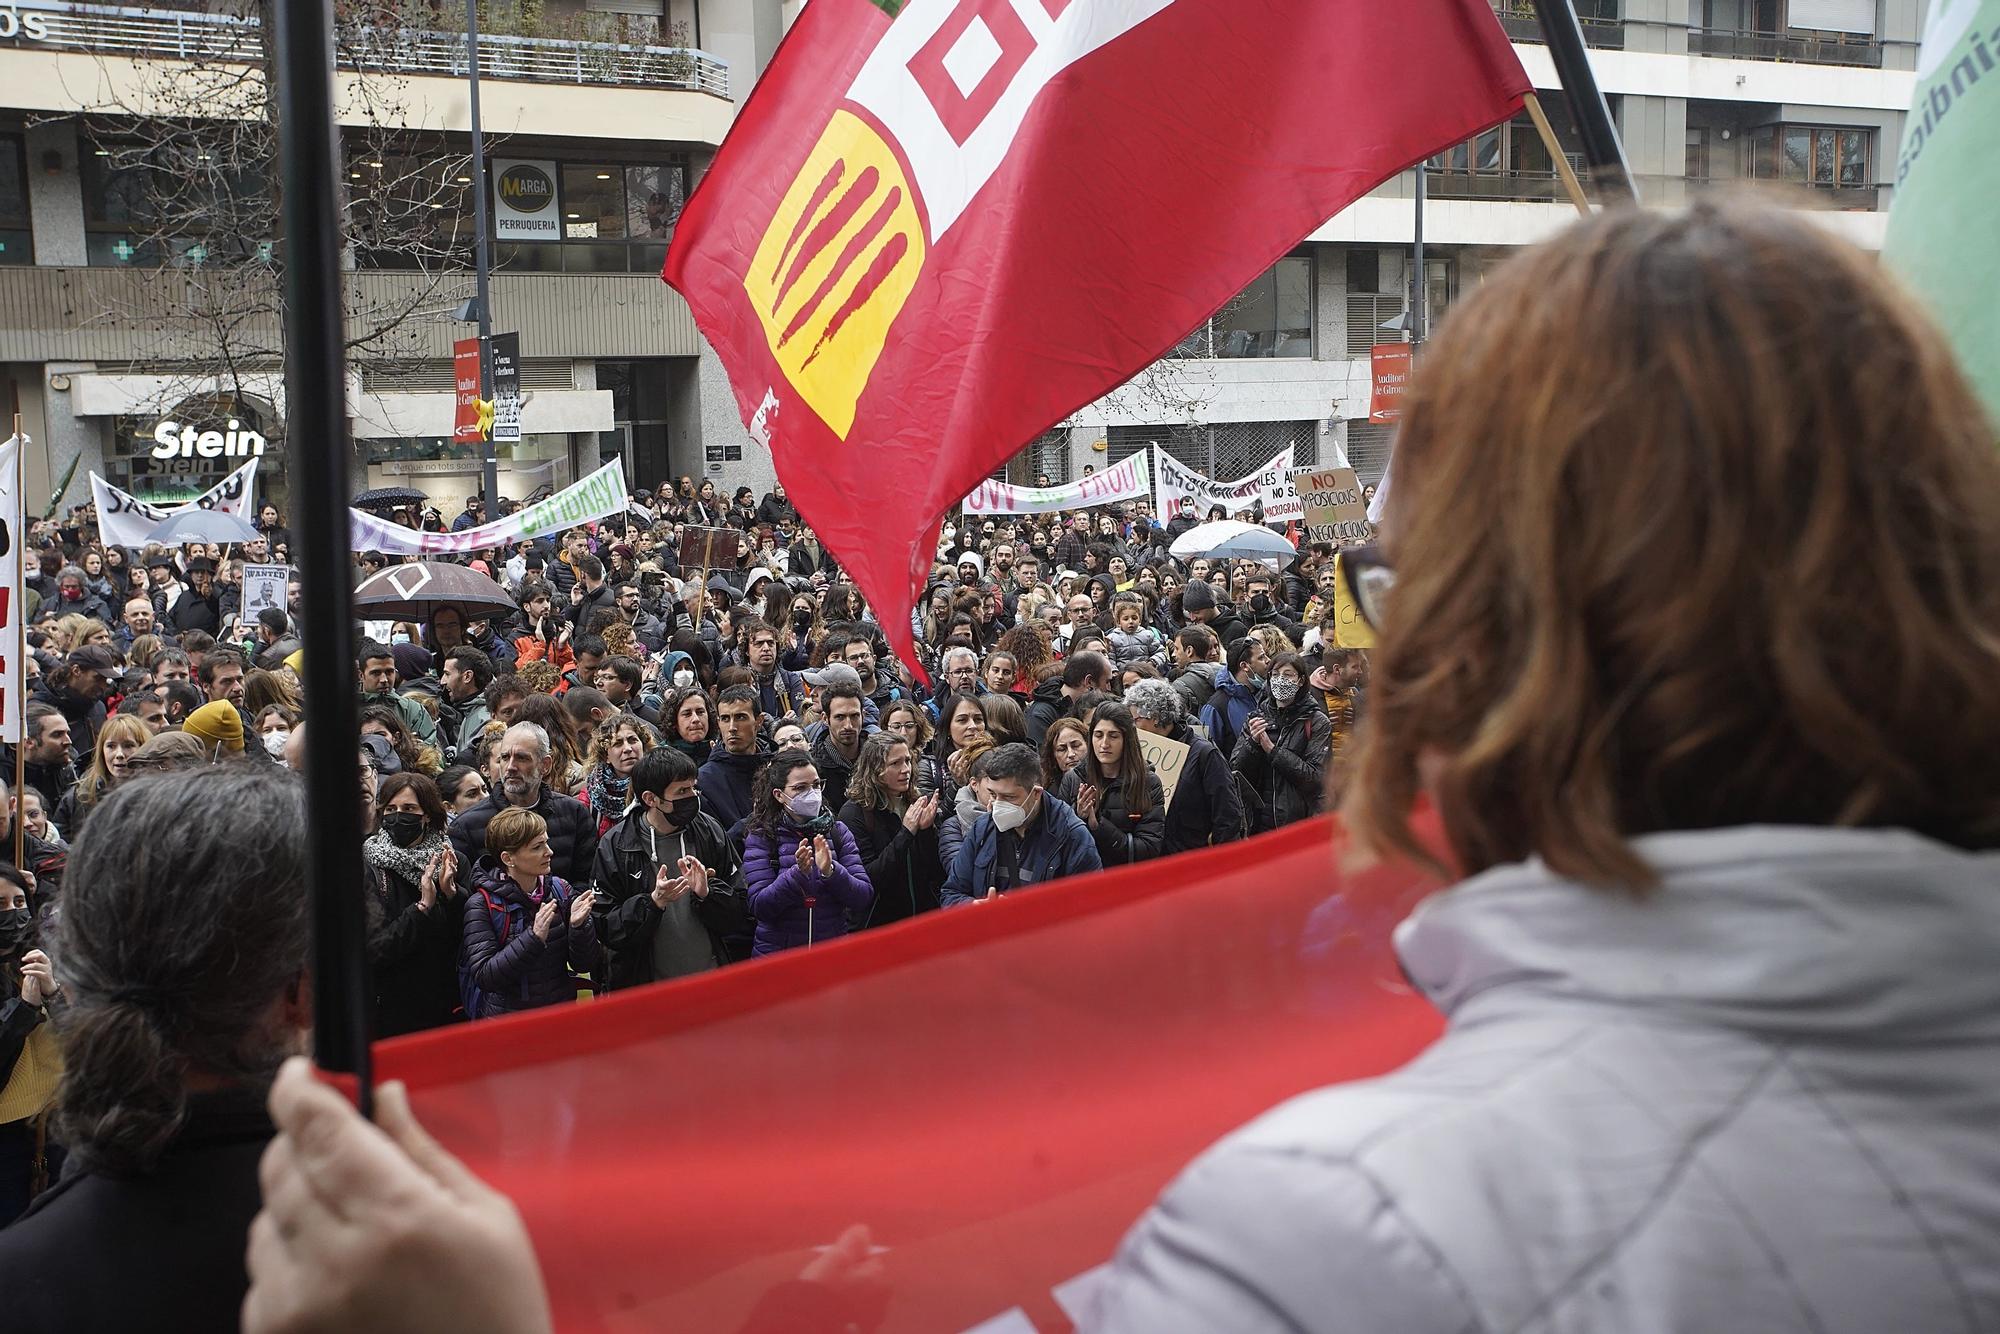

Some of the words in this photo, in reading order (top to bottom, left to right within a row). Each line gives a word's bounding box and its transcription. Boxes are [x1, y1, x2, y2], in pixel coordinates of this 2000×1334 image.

[501, 176, 548, 197] MARGA
[500, 219, 557, 231] PERRUQUERIA
[1377, 373, 1405, 384] Auditori
[151, 419, 265, 459] Stein
[425, 463, 437, 471] no
[438, 462, 455, 471] tots
[456, 463, 475, 471] som
[1260, 472, 1277, 487] LES
[1310, 473, 1336, 490] NO
[1272, 487, 1284, 499] NO
[1264, 502, 1303, 518] MACROGRAN
[1310, 520, 1370, 542] NEGOCIACIONS
[246, 570, 286, 580] WANTED
